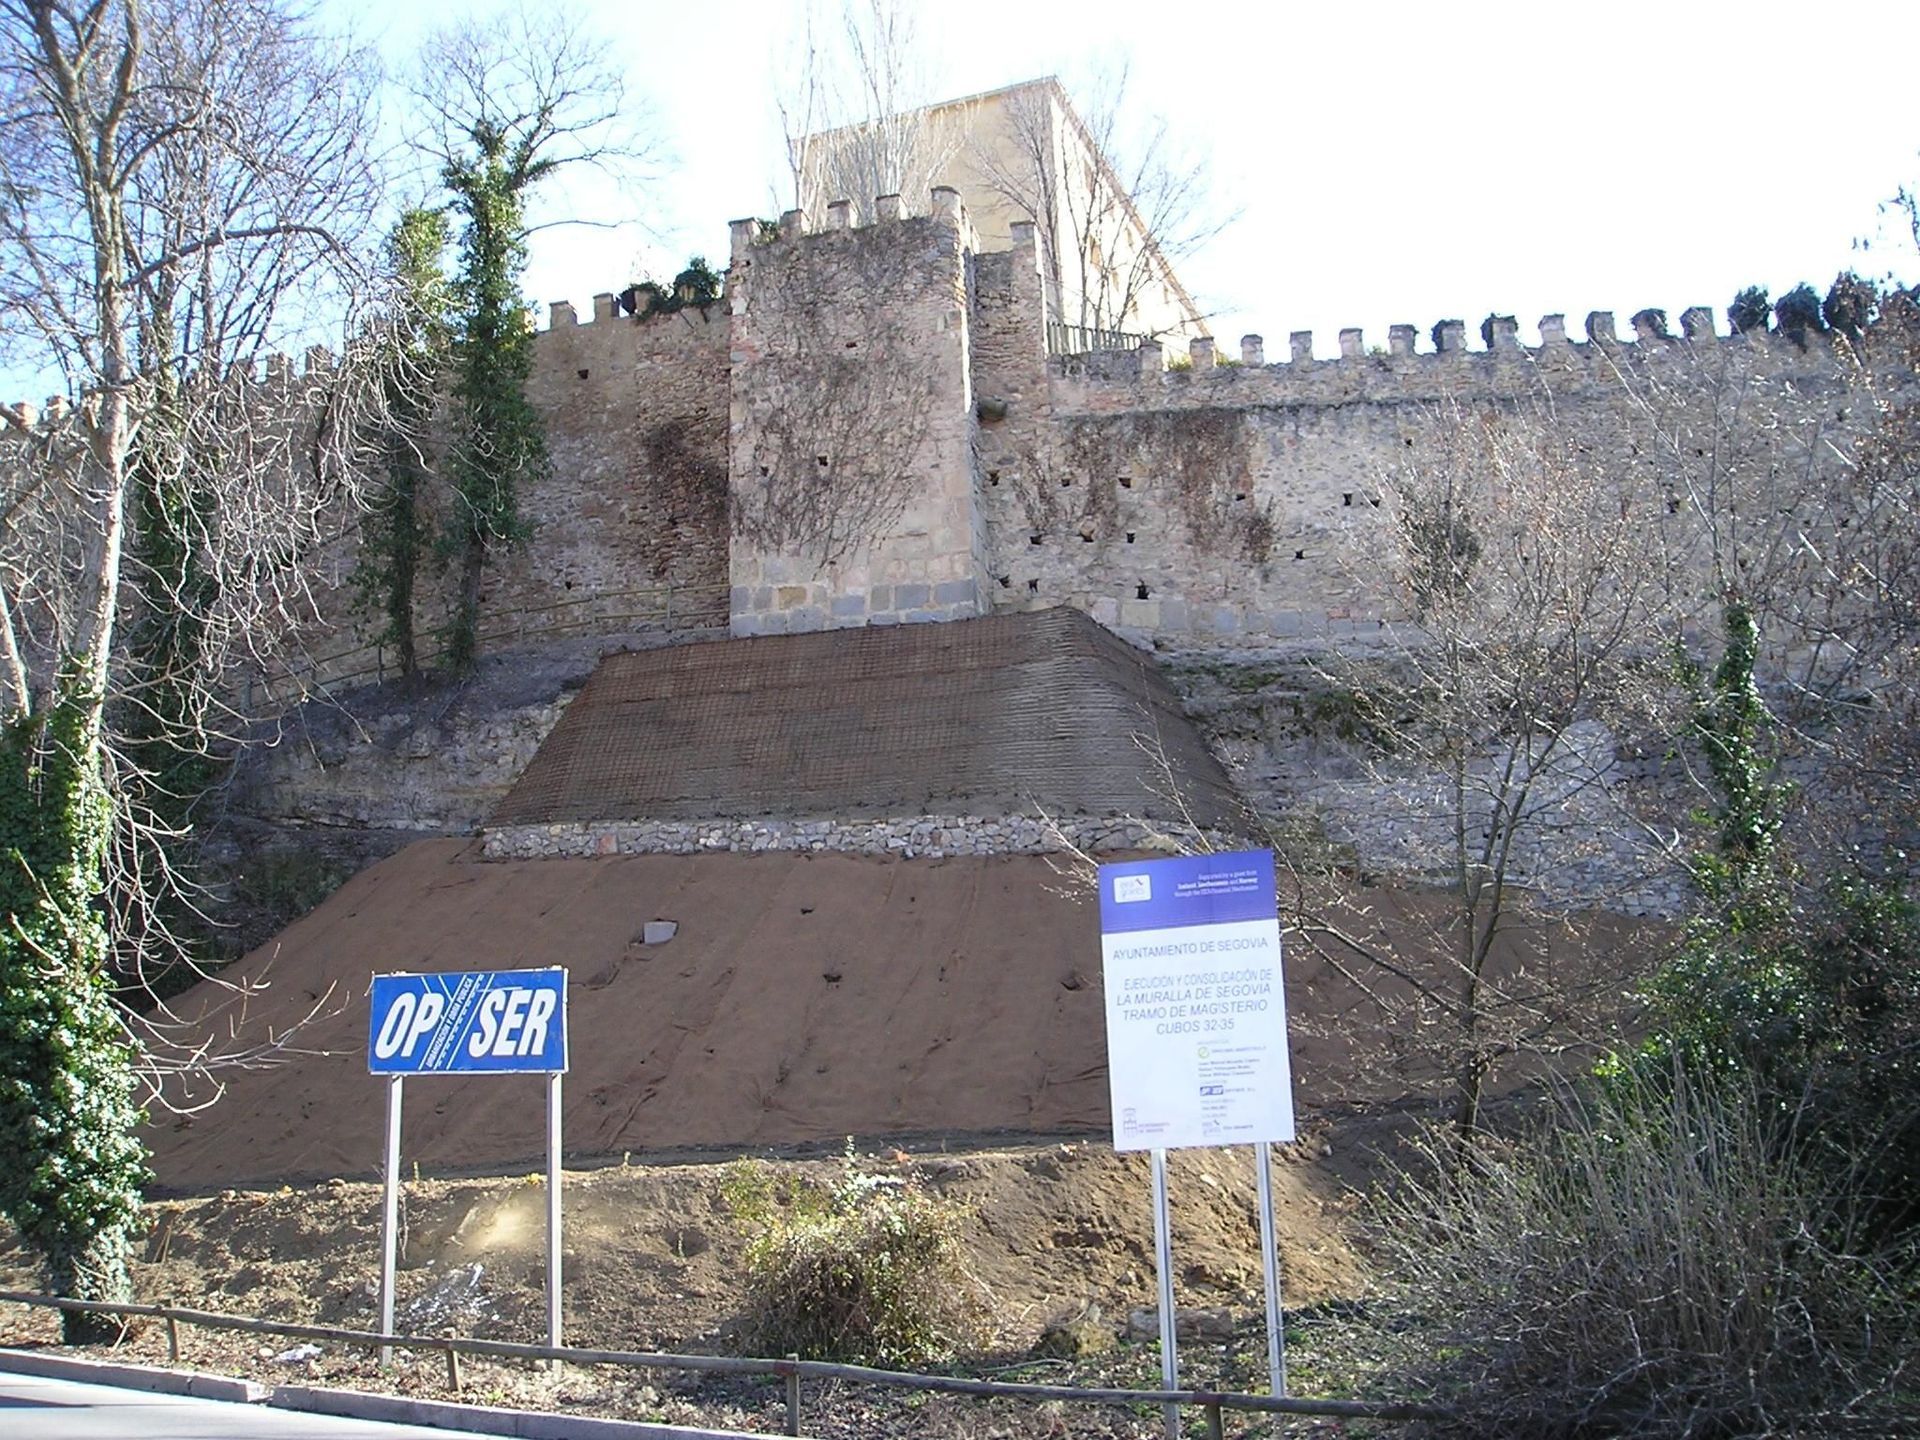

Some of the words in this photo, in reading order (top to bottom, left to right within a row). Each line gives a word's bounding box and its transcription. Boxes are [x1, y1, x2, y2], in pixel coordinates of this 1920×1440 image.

[1112, 943, 1198, 960] AYUNTAMIENTO
[1200, 940, 1216, 953] DE
[1218, 937, 1269, 951] SEGOVIA
[1176, 975, 1183, 986] Y
[1259, 969, 1272, 982] DE
[1116, 994, 1132, 1006] LA
[1134, 989, 1192, 1005] MURALLA
[1195, 987, 1212, 1000] DE
[1216, 983, 1271, 998] SEGOVIA
[1123, 1007, 1167, 1021] TRAMO
[1170, 1005, 1187, 1018] DE
[1190, 999, 1269, 1016] MAGISTERIO
[1156, 1020, 1200, 1035] CUBOS
[1203, 1018, 1235, 1032] 32-35
